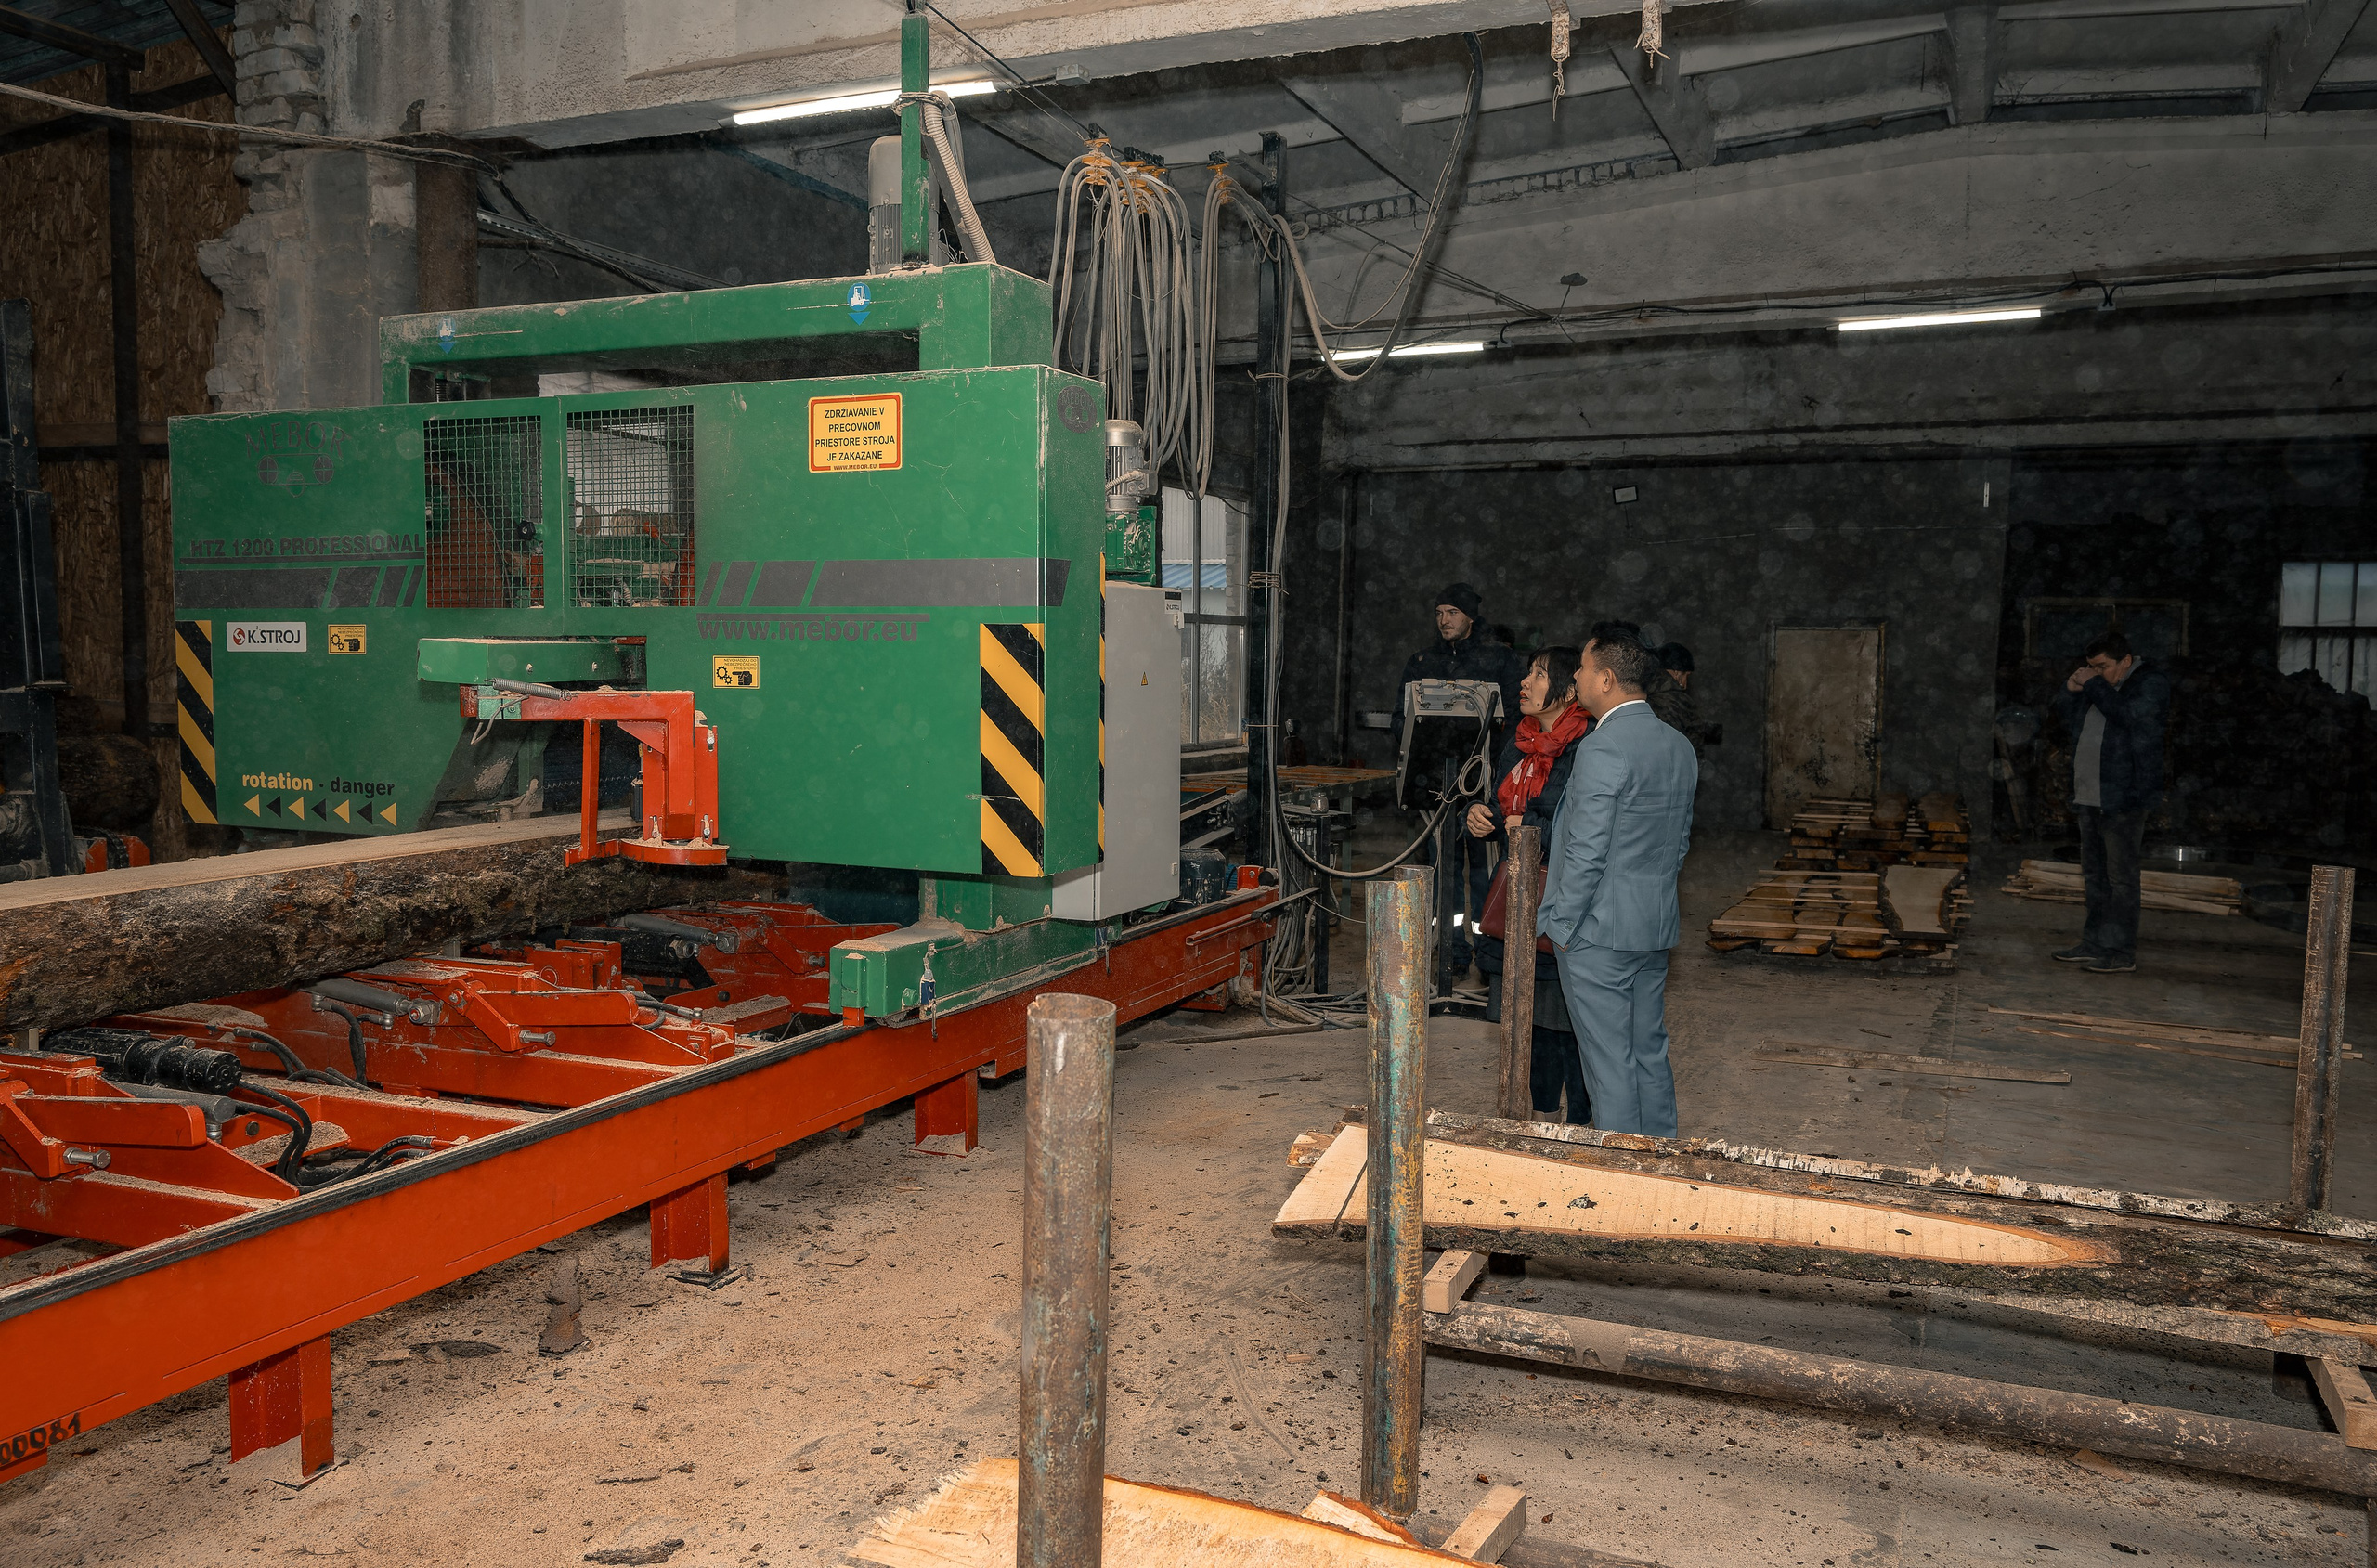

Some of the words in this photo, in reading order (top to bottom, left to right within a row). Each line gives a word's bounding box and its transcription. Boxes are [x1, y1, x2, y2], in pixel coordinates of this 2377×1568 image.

[825, 408, 877, 419] ZDRŽIAVANIE
[878, 407, 885, 415] V
[828, 421, 881, 433] PRECOVNOM
[244, 421, 351, 461] MEBOR
[815, 437, 861, 447] PRIESTORE
[863, 435, 895, 446] STROJA
[826, 452, 837, 461] JE
[838, 450, 883, 461] ZAKAZANE
[190, 538, 226, 557] HTZ
[232, 538, 274, 556] 1200
[279, 534, 425, 555] PROFESSIONAL
[697, 617, 917, 641] www.mebor.eu
[242, 771, 313, 791] rotation
[330, 777, 396, 798] danger
